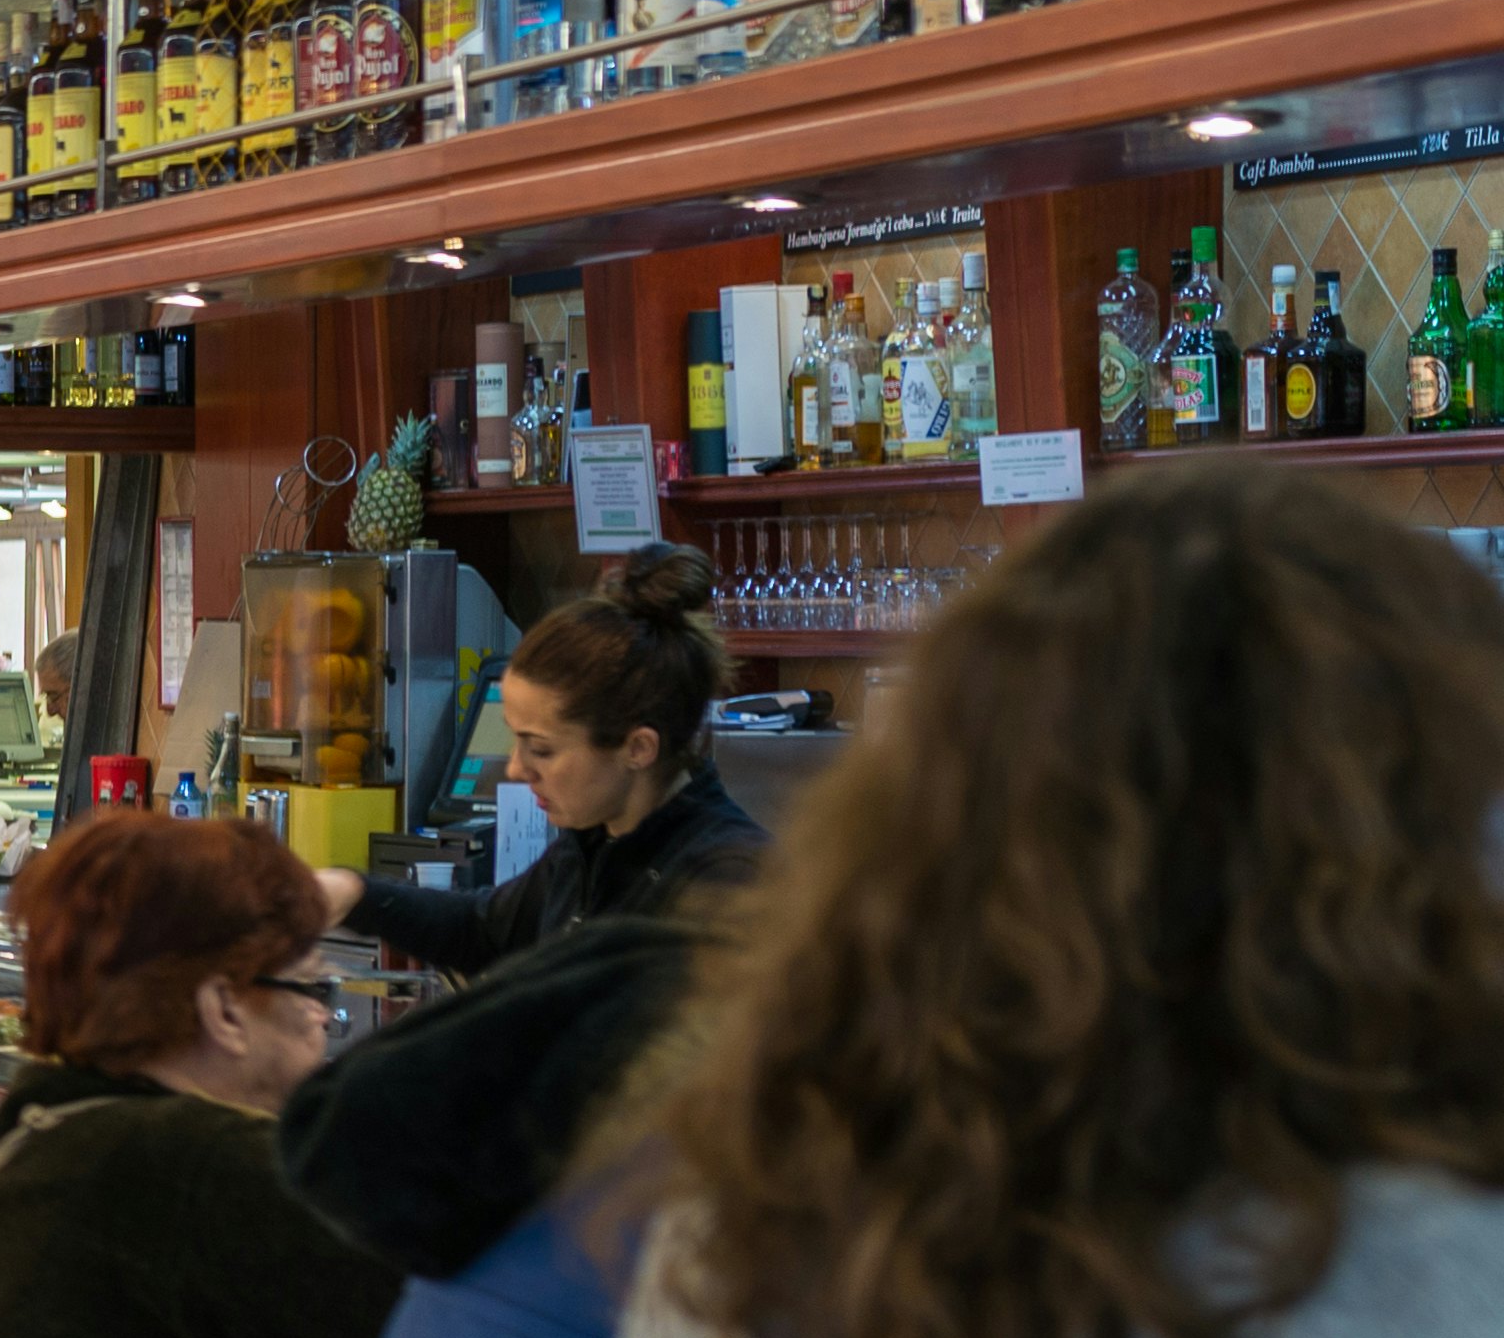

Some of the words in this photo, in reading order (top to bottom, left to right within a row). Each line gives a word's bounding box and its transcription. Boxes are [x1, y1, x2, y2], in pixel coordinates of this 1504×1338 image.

[313, 64, 350, 90] Pujol
[356, 56, 400, 83] Pujol
[1239, 158, 1266, 187] Café
[1268, 151, 1315, 178] Bombón
